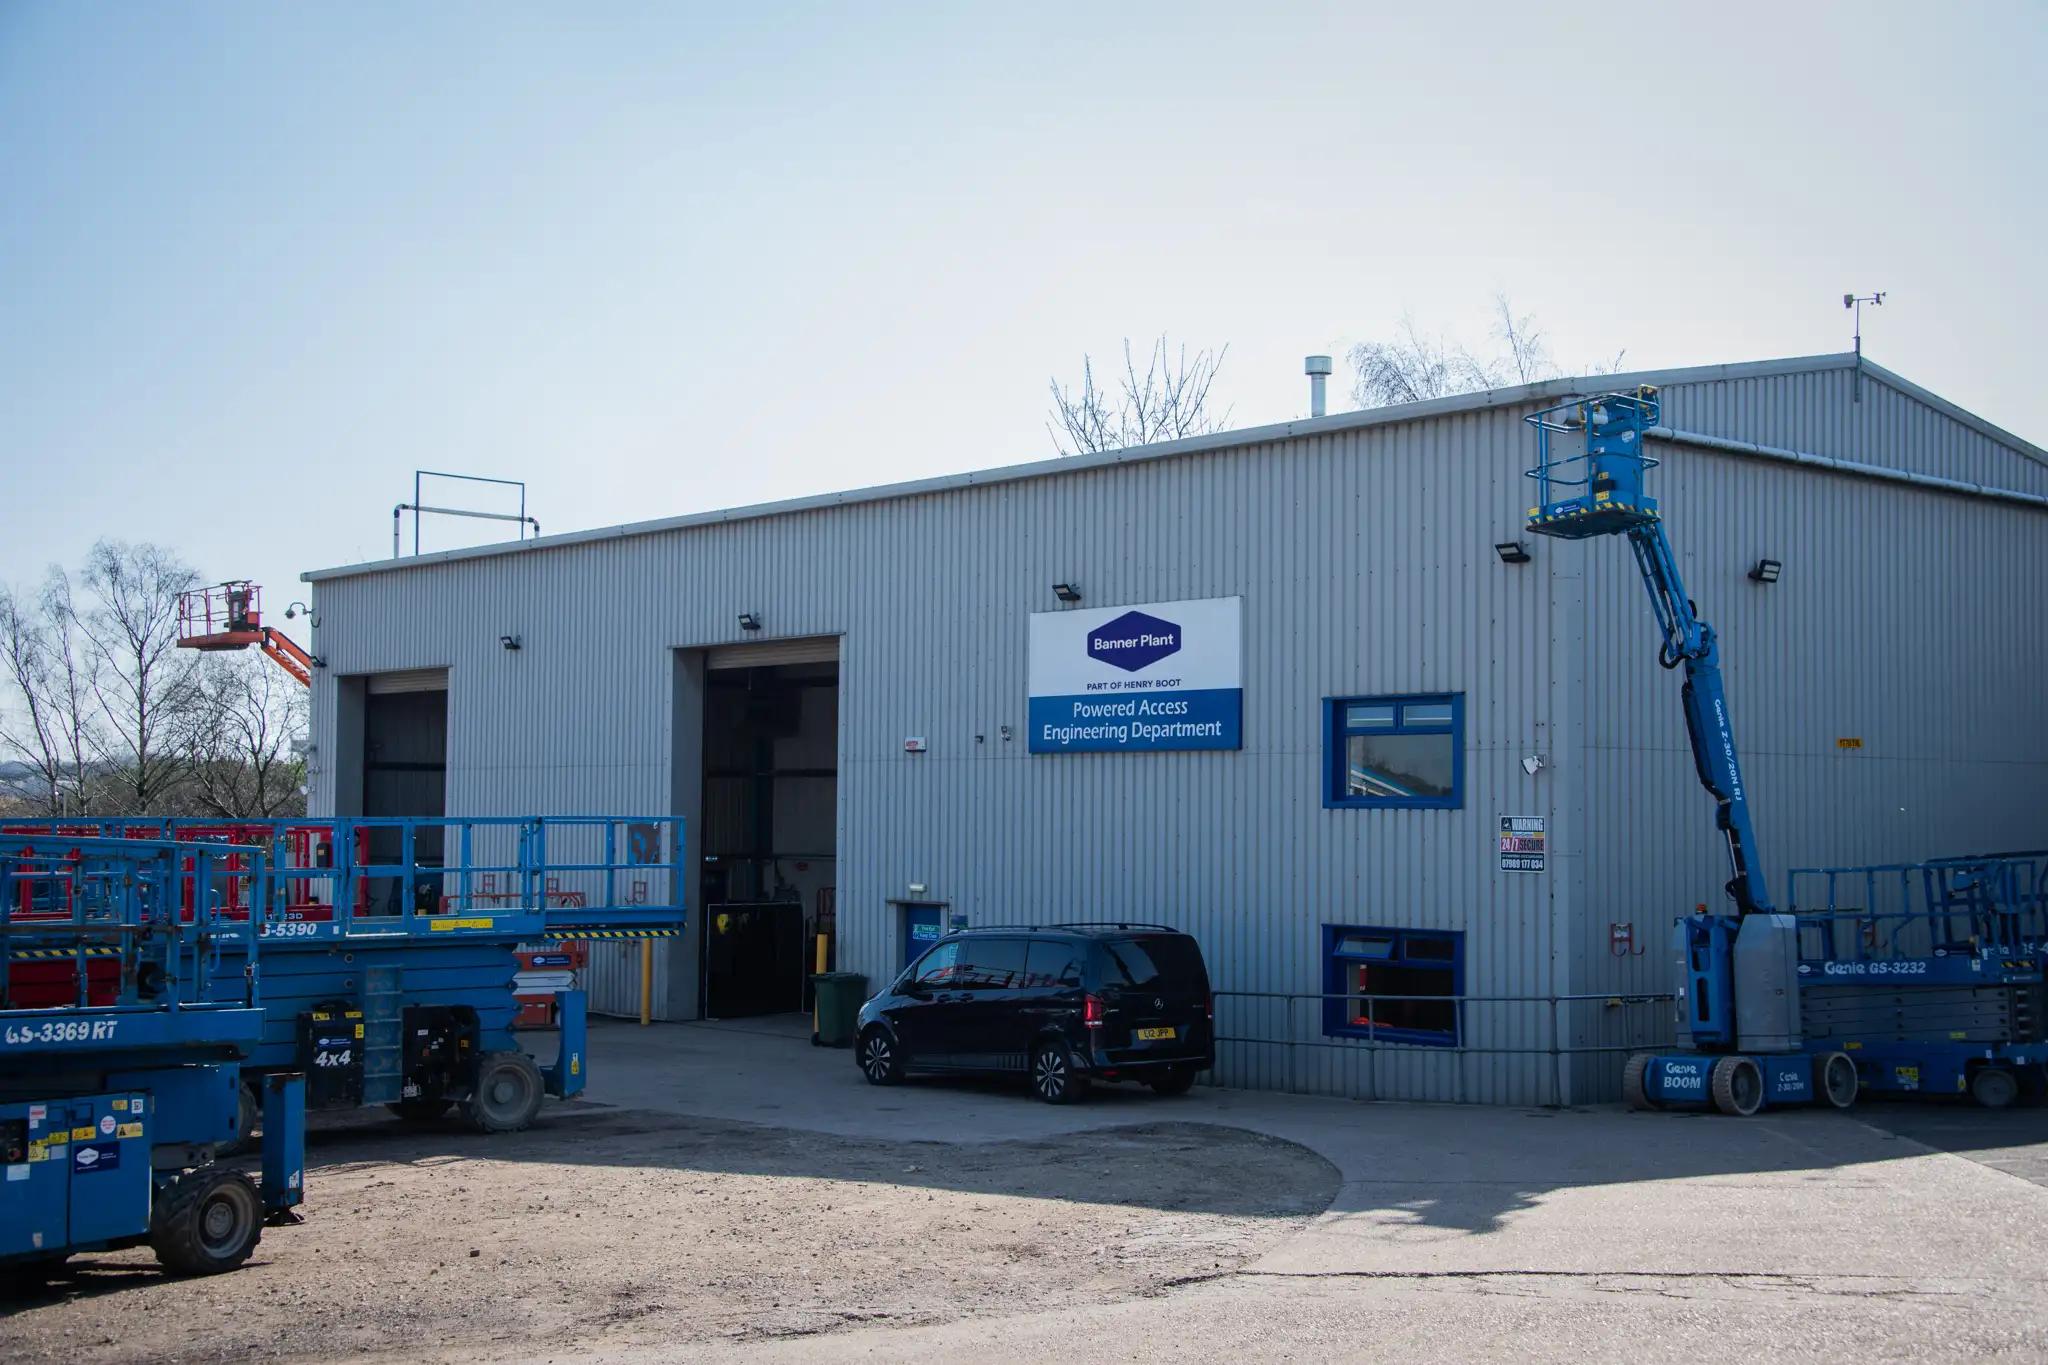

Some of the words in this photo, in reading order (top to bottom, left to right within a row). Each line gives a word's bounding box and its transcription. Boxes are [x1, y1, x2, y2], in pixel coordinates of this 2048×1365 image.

[1094, 638, 1138, 650] Banner
[1140, 634, 1174, 647] Plant
[1086, 683, 1108, 691] PART
[1110, 682, 1122, 690] OF
[1124, 681, 1153, 689] HENRY
[1156, 679, 1181, 688] BOOT
[1073, 699, 1135, 718] Powered
[1138, 699, 1188, 716] Access
[1043, 722, 1128, 745] Engineering
[1131, 720, 1222, 742] Department
[1714, 699, 1725, 728] Genie
[1721, 730, 1739, 786] Z-30/20N
[1511, 818, 1543, 831] WARNING
[1501, 837, 1519, 852] 24/7
[1519, 839, 1544, 851] SECURE
[258, 923, 318, 938] S-5390
[1824, 961, 1866, 975] Genie
[1868, 961, 1926, 975] GS-3232
[315, 1049, 351, 1067] 4x4
[1666, 1062, 1697, 1074] Genie
[1663, 1076, 1701, 1089] BOOM
